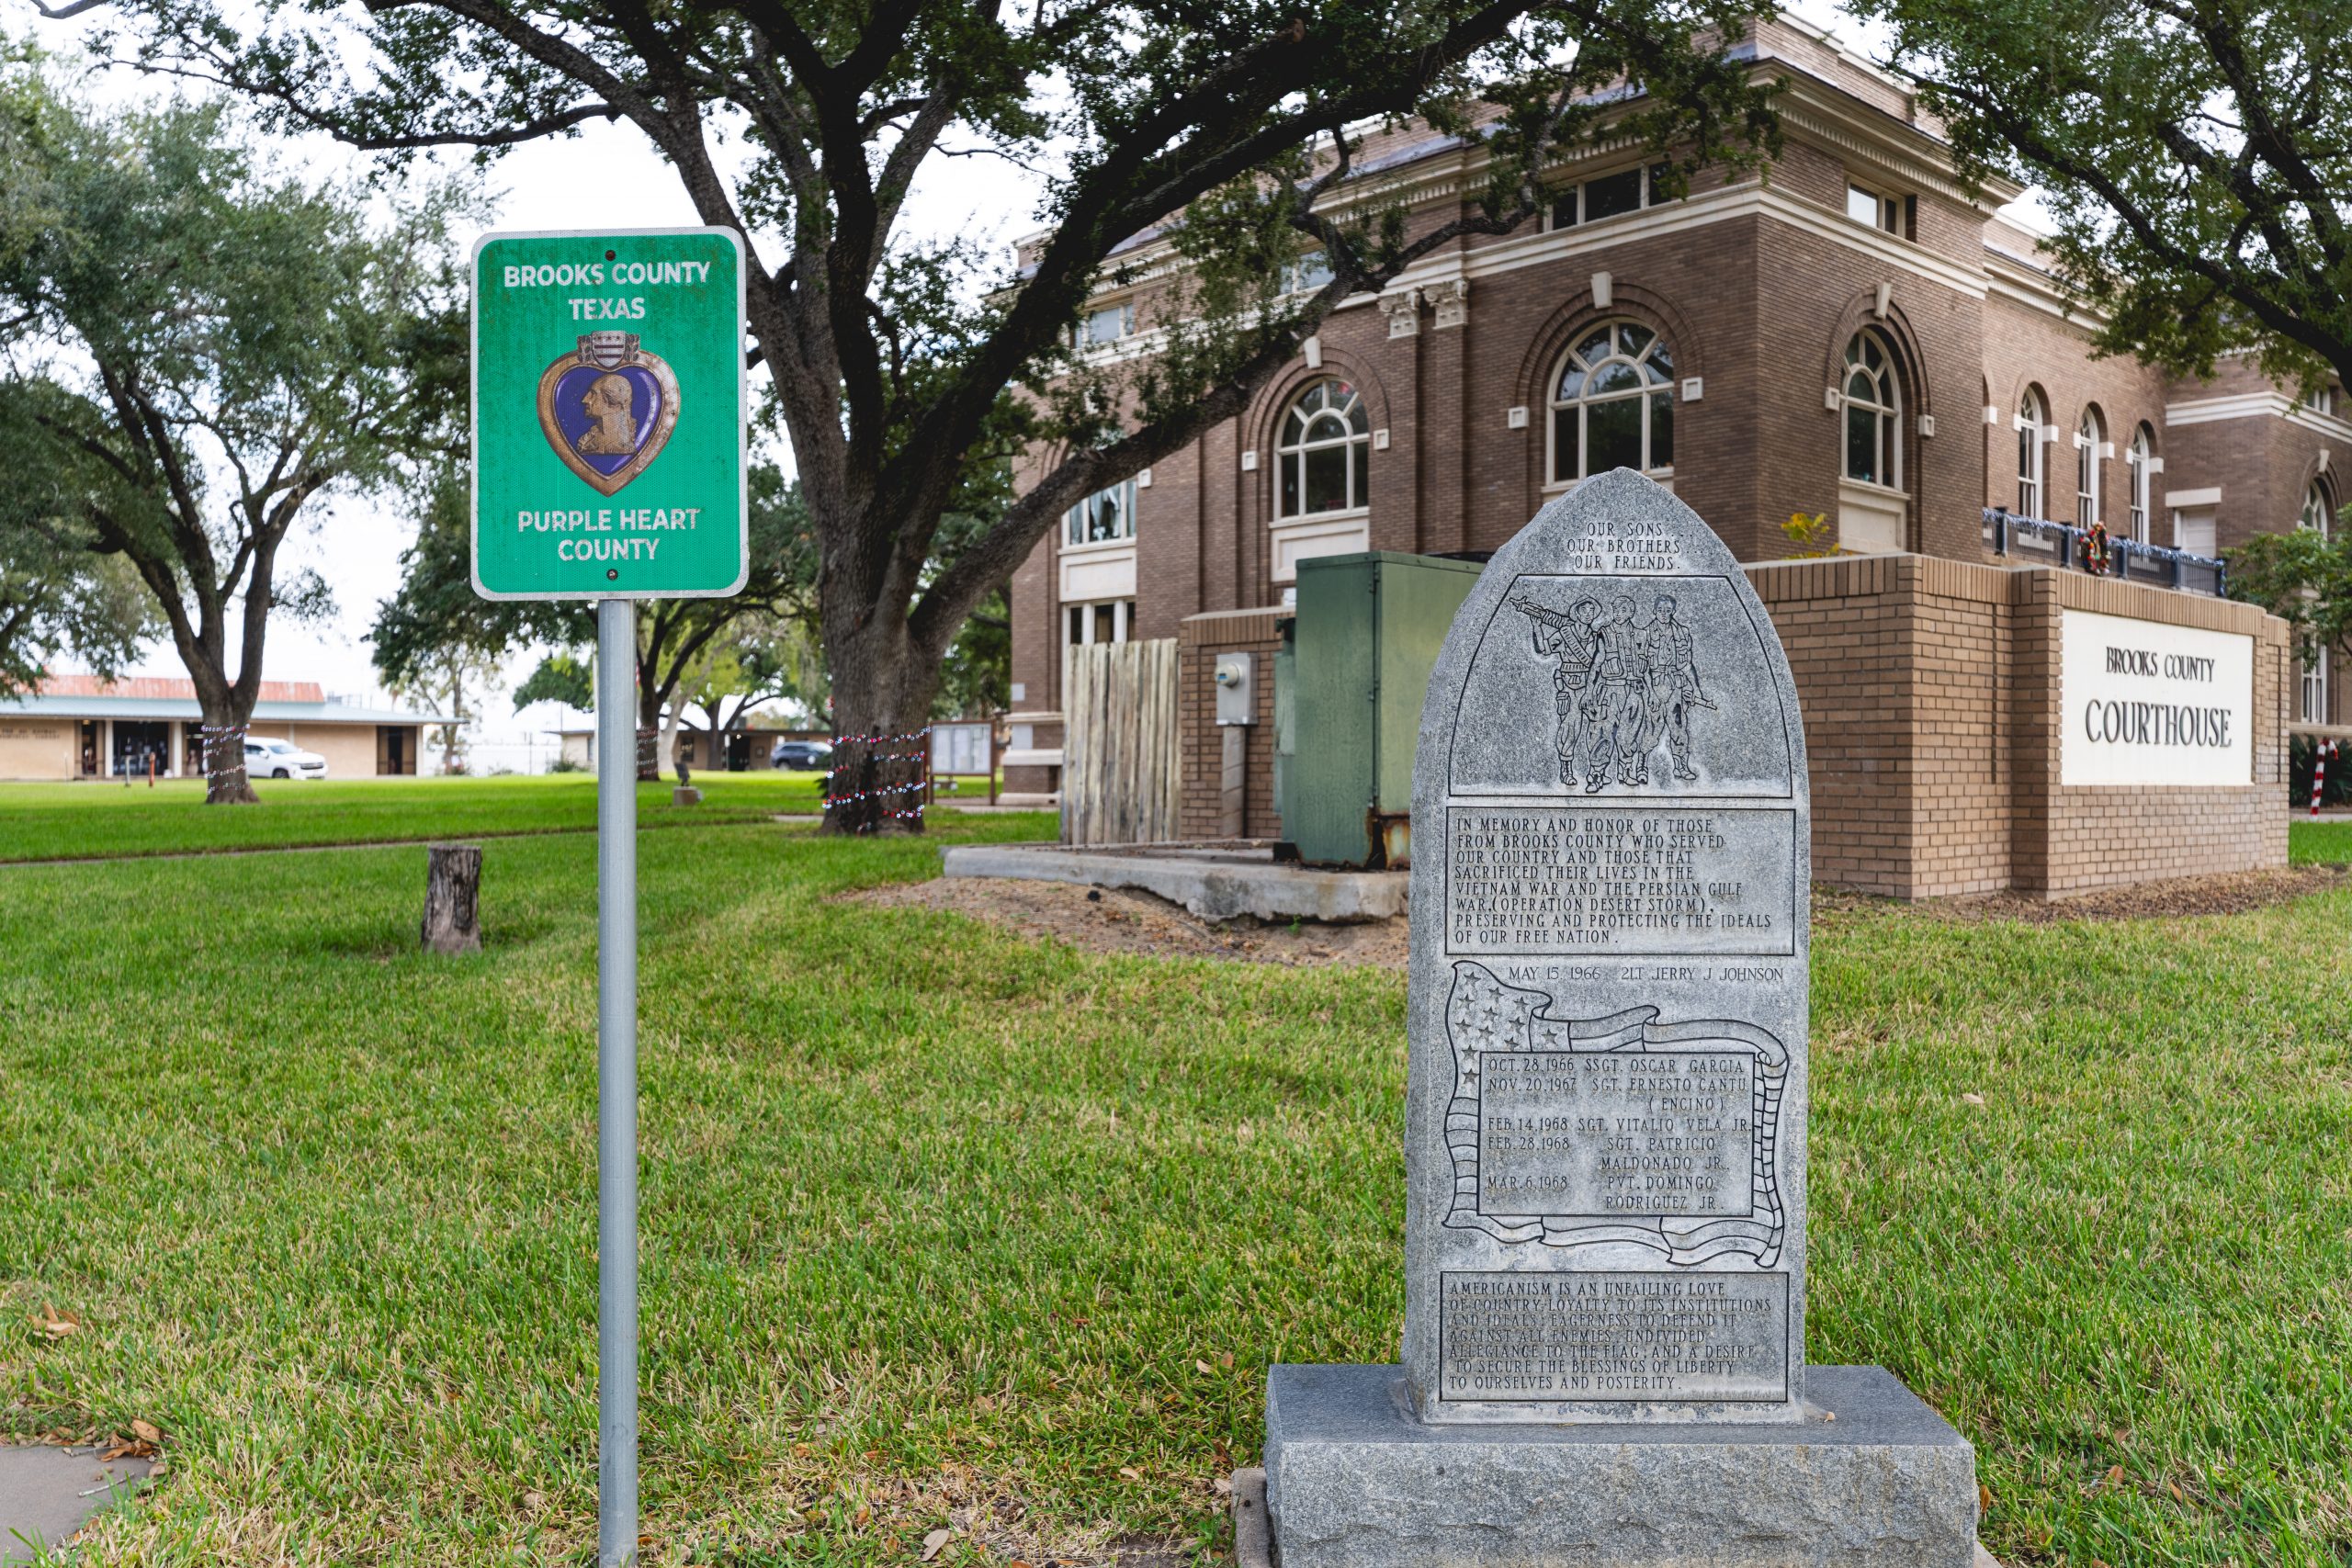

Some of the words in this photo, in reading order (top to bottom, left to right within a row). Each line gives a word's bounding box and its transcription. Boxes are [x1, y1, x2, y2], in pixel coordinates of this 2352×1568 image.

[503, 264, 605, 288] BROOKS
[611, 261, 710, 285] COUNTY
[568, 297, 646, 321] TEXAS
[517, 510, 612, 533] PURPLE
[620, 508, 701, 531] HEART
[1587, 522, 1615, 536] OUR
[558, 538, 660, 561] COUNTY
[1567, 538, 1594, 553] OUR
[1575, 555, 1602, 569] OUR
[1615, 556, 1680, 570] FRIENDS.
[2106, 646, 2158, 677] BROOKS
[2164, 654, 2215, 683] COUNTY
[2085, 698, 2233, 748] COURTHOUSE
[1457, 818, 1472, 831] IN
[1480, 818, 1540, 831] MEMORY
[1547, 818, 1577, 832] AND
[1585, 818, 1634, 832] HONOR
[1643, 818, 1659, 832] OF
[1668, 819, 1713, 832] THOSE
[1457, 834, 1495, 848] FROM
[1502, 835, 1559, 848] BROOKS
[1566, 835, 1623, 848] COUNTY
[1633, 835, 1664, 849] WHO
[1671, 835, 1724, 849] SERVED
[1456, 850, 1484, 863] OUR
[1492, 850, 1559, 863] COUNTRY
[1566, 851, 1597, 863] AND
[1604, 850, 1649, 864] THOSE
[1657, 851, 1693, 864] THAT
[1454, 865, 1538, 879] SACRIFICED
[1546, 866, 1589, 880] THEIR
[1597, 866, 1636, 880] LIVES
[1644, 866, 1658, 880] IN
[1666, 866, 1693, 880] THE
[1455, 882, 1521, 896] VIETNAM
[1529, 883, 1559, 896] WAR
[1567, 883, 1597, 896] AND
[1604, 883, 1631, 896] THE
[1639, 883, 1700, 896] PERSIAN
[1708, 883, 1742, 896] GULF
[1590, 898, 1641, 911] DESERT
[1456, 914, 1545, 927] PRESERVING
[1552, 914, 1581, 927] AND
[1589, 914, 1679, 928] PROTECTING
[1686, 915, 1713, 927] THE
[1721, 915, 1771, 928] IDEALS
[1455, 931, 1472, 943] OF
[1479, 930, 1507, 943] OUR
[1516, 931, 1549, 943] FREE
[1509, 966, 1539, 980] MAY
[1569, 966, 1600, 980] 1966
[1621, 966, 1645, 980] 2LT
[1652, 966, 1696, 980] JERRY
[1703, 966, 1713, 981] J
[1719, 966, 1784, 981] JOHNSON
[1586, 1058, 1623, 1072] SSGT.
[1630, 1058, 1676, 1072] OSCAR
[1690, 1059, 1745, 1073] GARCIA
[1592, 1078, 1622, 1091] SGT.
[1630, 1077, 1691, 1091] ERNESTO
[1699, 1077, 1746, 1091] CANTU
[1578, 1118, 1609, 1132] SGT.
[1616, 1118, 1674, 1132] VITALIO
[1687, 1119, 1722, 1132] VELA
[1732, 1118, 1752, 1132] JR.
[1608, 1138, 1638, 1151] SGT.
[1649, 1137, 1715, 1151] PATRICIO
[1601, 1156, 1691, 1170] MALDONADO
[1705, 1157, 1730, 1170] JR.
[1608, 1177, 1640, 1190] PVT.
[1646, 1176, 1713, 1190] DOMINGO
[1606, 1196, 1688, 1209] RODRIGUEZ
[1700, 1196, 1724, 1210] JR.
[1451, 1282, 1551, 1295] AMERICANISM
[1559, 1282, 1570, 1295] IS
[1578, 1283, 1597, 1295] AN
[1605, 1282, 1681, 1295] UNFAILING
[1689, 1282, 1724, 1295] LOVE
[1450, 1299, 1467, 1311] OF
[1548, 1299, 1609, 1311] LOYALTY
[1619, 1299, 1635, 1311] TO
[1644, 1299, 1665, 1311] ITS
[1672, 1299, 1771, 1312] INSTITUTIONS
[1451, 1314, 1479, 1326] AND
[1551, 1314, 1630, 1326] EAGERNESS
[1637, 1314, 1655, 1326] TO
[1662, 1314, 1715, 1327] DEFEND
[1724, 1314, 1736, 1327] IT
[1450, 1330, 1510, 1342] AGAINST
[1520, 1330, 1544, 1342] ALL
[1625, 1330, 1705, 1343] UNDIVIDED
[1450, 1345, 1538, 1358] ALLEGIANCE
[1545, 1345, 1562, 1358] TO
[1570, 1345, 1597, 1358] THE
[1652, 1345, 1681, 1359] AND
[1690, 1345, 1698, 1359] A
[1705, 1345, 1755, 1359] DESIRE
[1455, 1360, 1472, 1373] TO
[1478, 1360, 1532, 1373] SECURE
[1539, 1360, 1566, 1373] THE
[1572, 1360, 1645, 1373] BLESSINGS
[1653, 1360, 1669, 1373] OF
[1677, 1360, 1736, 1373] LIBERTY
[1450, 1376, 1467, 1389] TO
[1475, 1376, 1553, 1390] OURSELVES
[1560, 1376, 1589, 1389] AND
[1597, 1376, 1681, 1389] POSTERITY.
